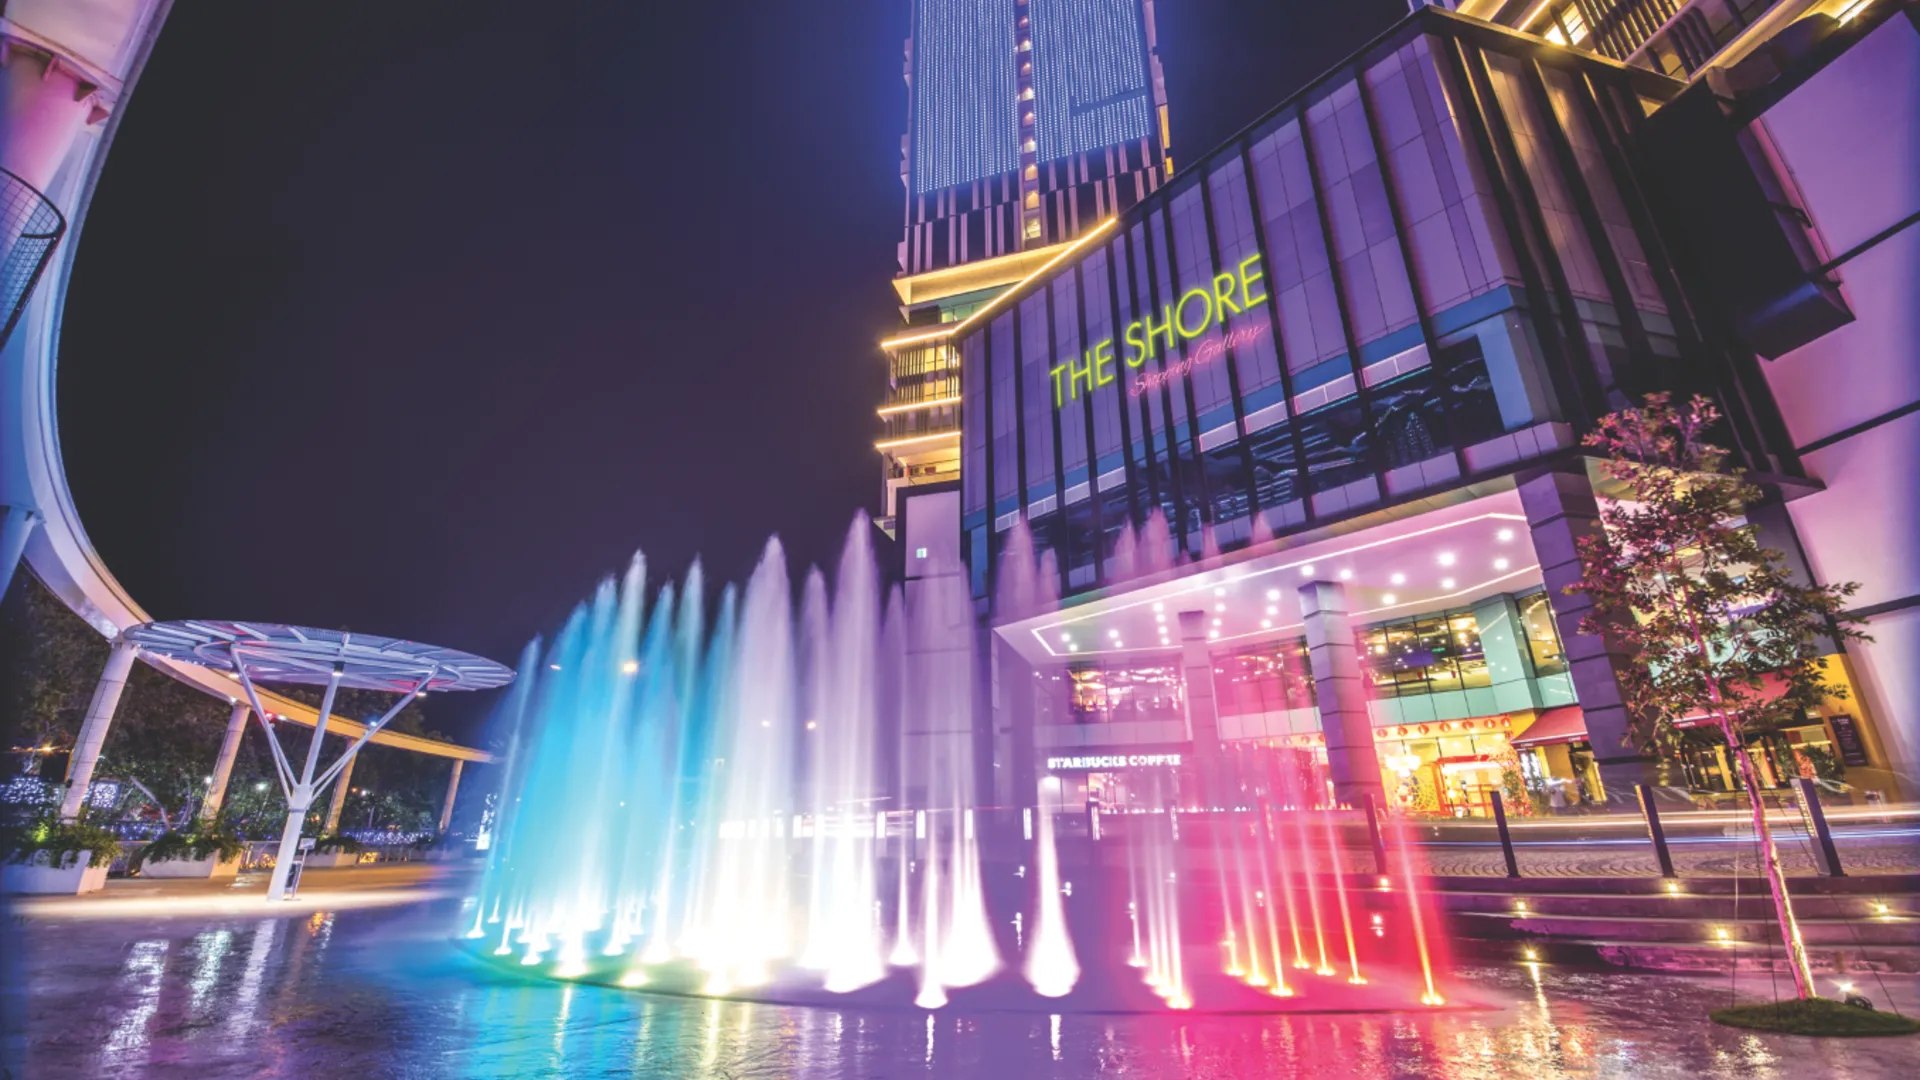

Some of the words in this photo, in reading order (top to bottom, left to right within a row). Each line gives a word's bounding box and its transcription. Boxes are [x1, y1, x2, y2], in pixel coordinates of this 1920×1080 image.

[1050, 339, 1115, 408] THE
[1125, 253, 1268, 368] SHORE
[1194, 323, 1269, 364] Gallery
[1047, 756, 1127, 769] STARBUCKS
[1128, 754, 1181, 767] COFFEE
